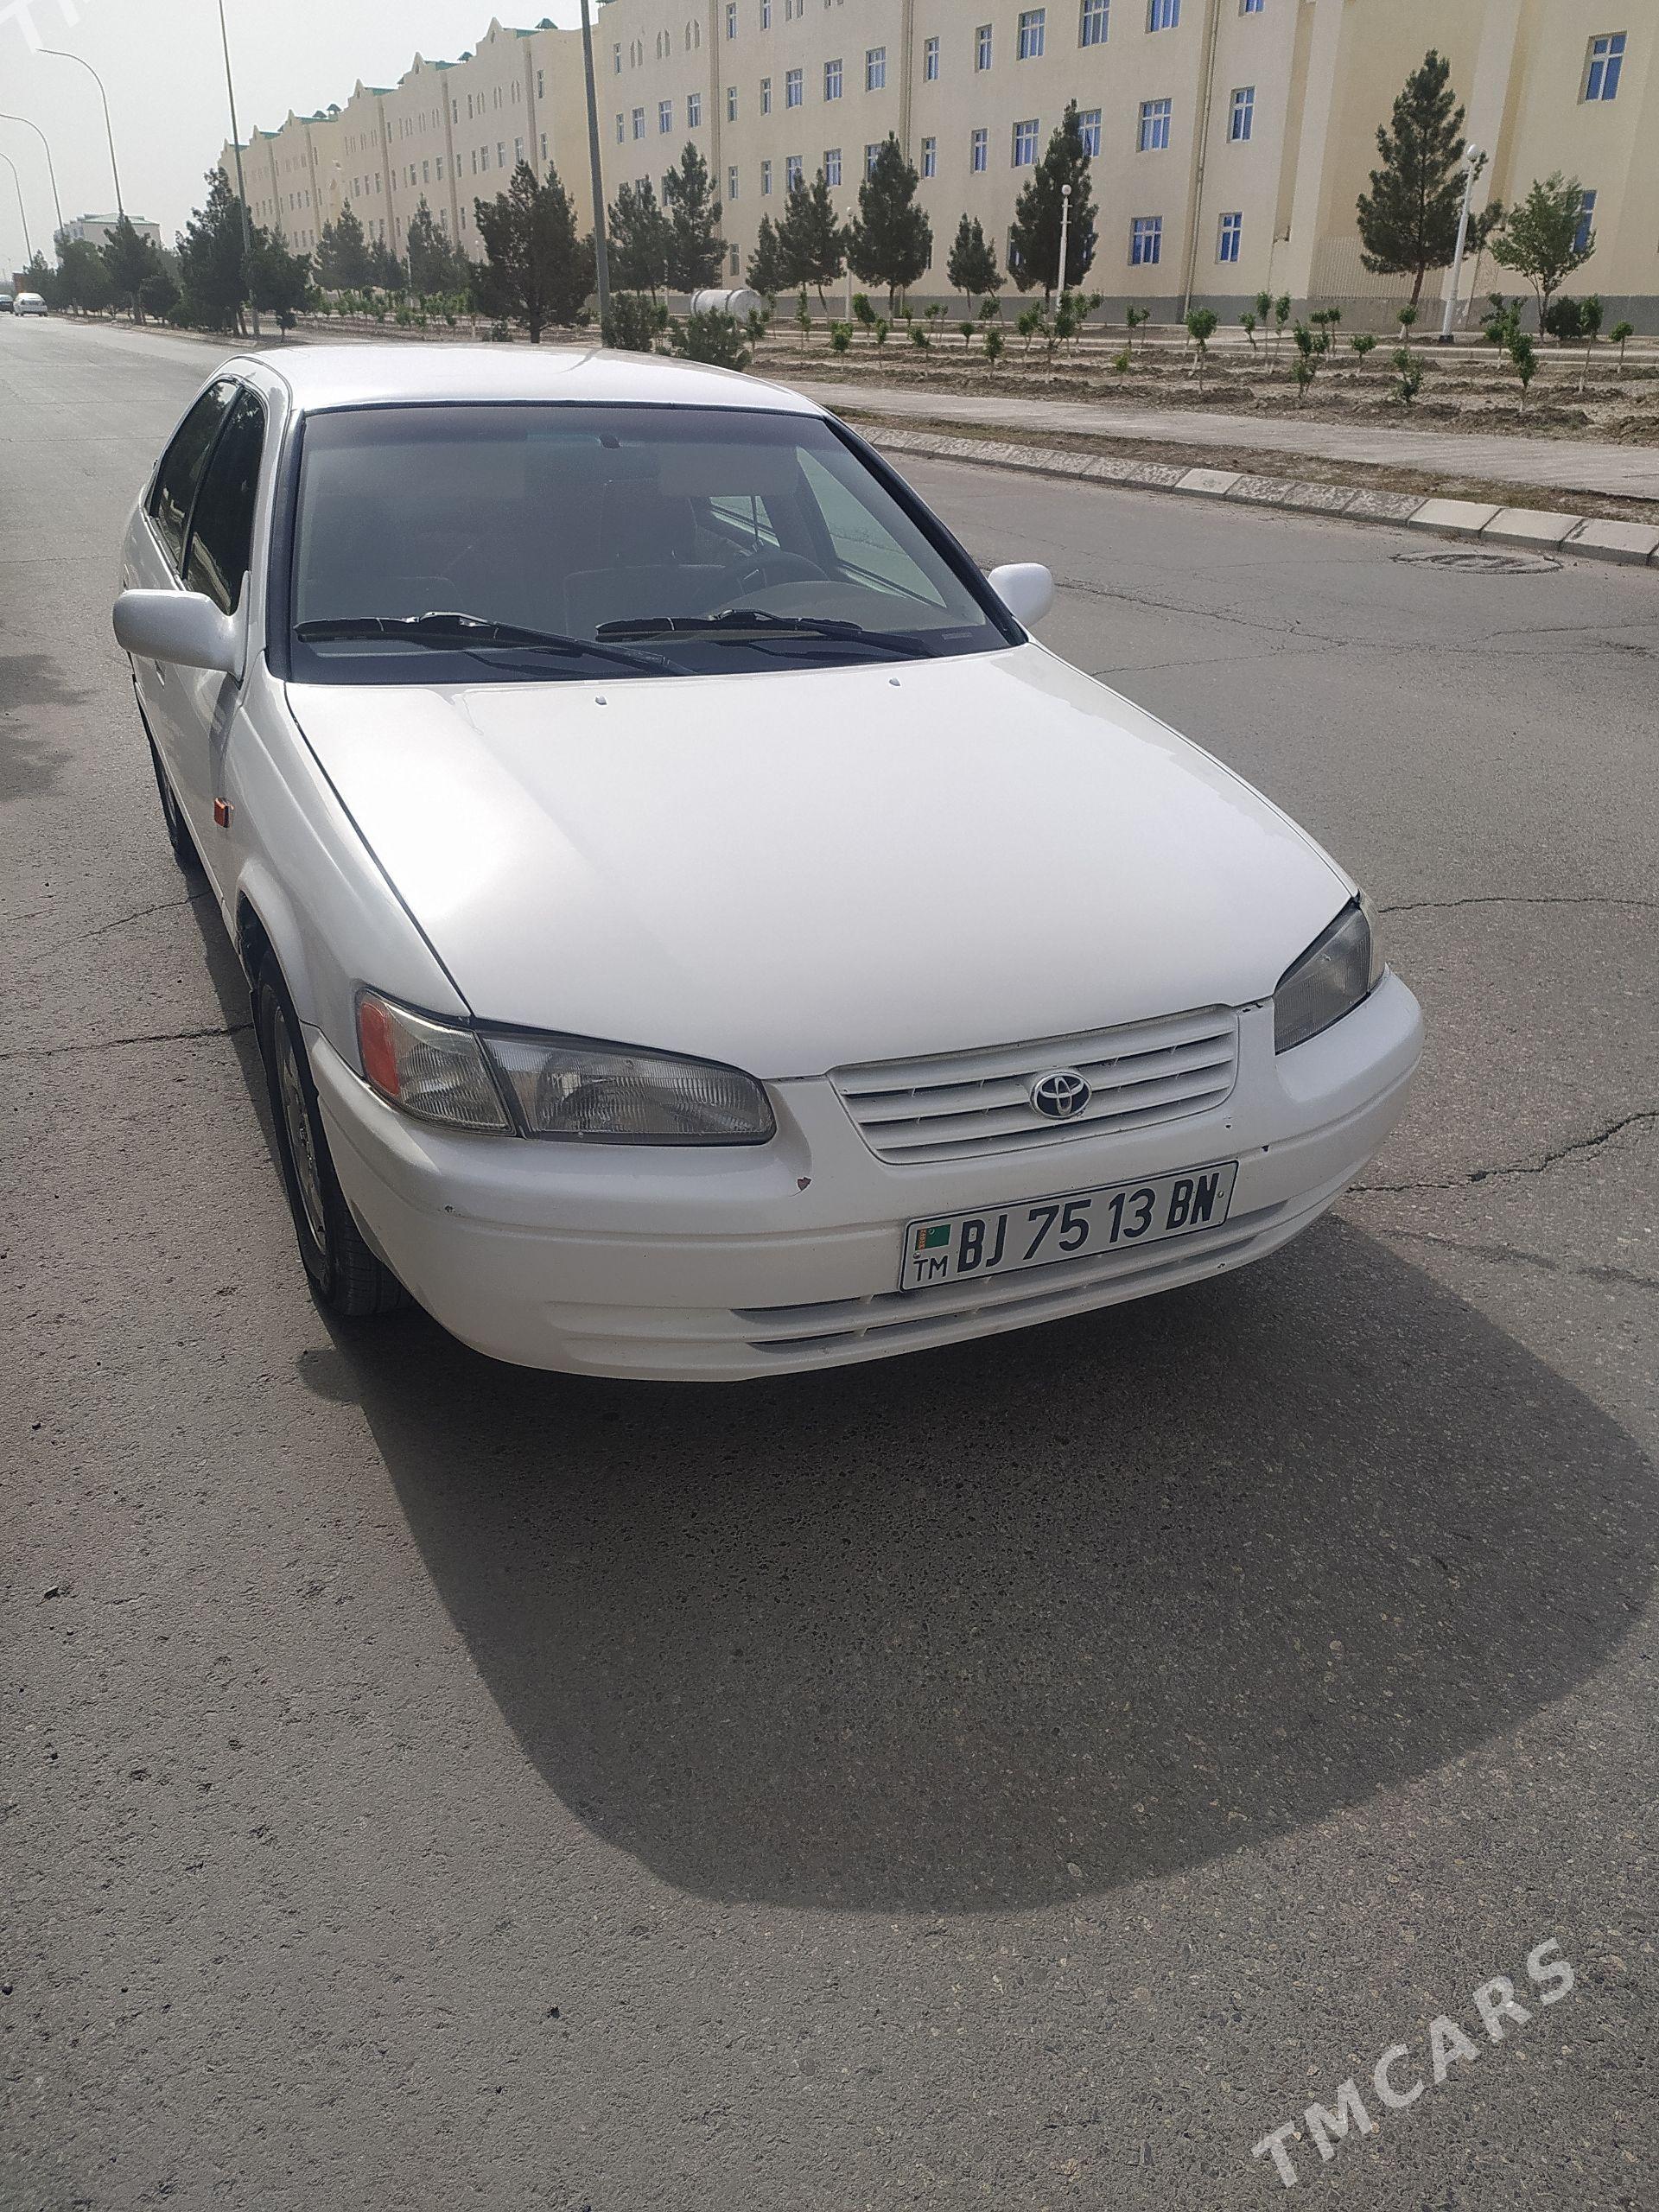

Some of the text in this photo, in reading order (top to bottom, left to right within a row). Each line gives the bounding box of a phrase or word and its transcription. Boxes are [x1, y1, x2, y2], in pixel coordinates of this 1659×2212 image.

[957, 1173, 1219, 1273] BJ 75 13 BN
[913, 1255, 947, 1282] TM
